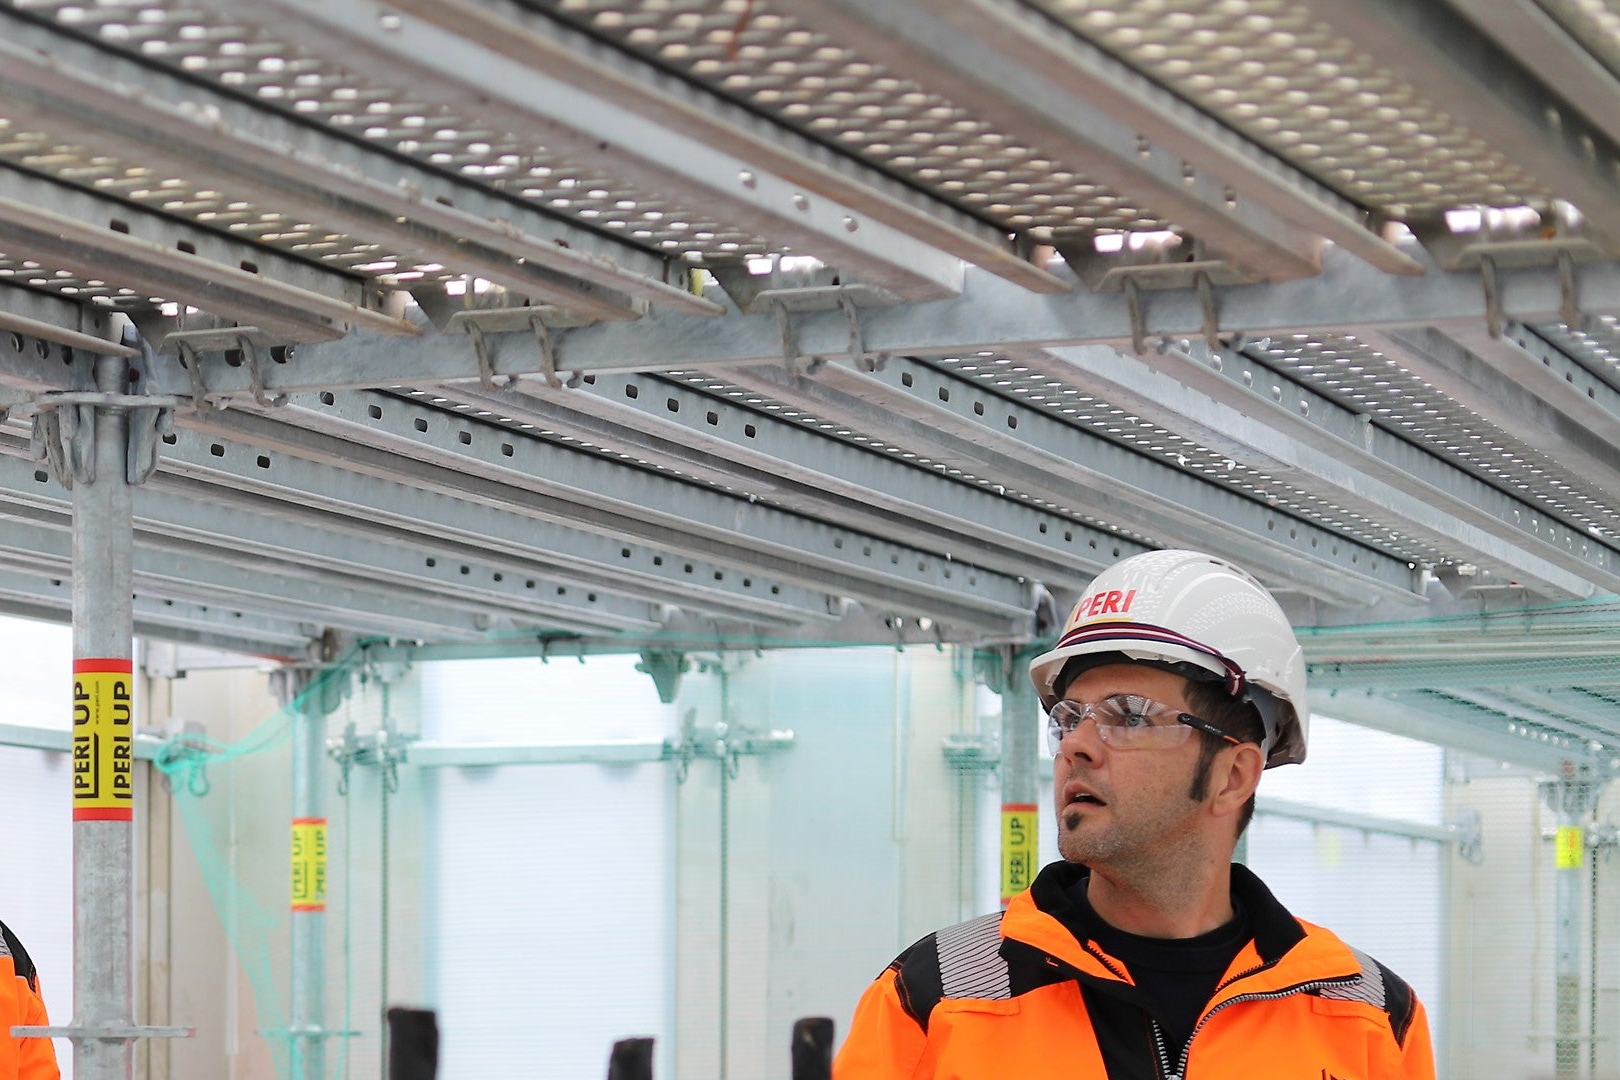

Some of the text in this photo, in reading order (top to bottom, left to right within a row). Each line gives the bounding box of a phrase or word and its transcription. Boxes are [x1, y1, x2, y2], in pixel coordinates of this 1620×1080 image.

[1075, 590, 1137, 622] PERI
[74, 681, 90, 789] PERI UP
[113, 680, 130, 789] PERI UP
[1010, 817, 1025, 885] PERI UP
